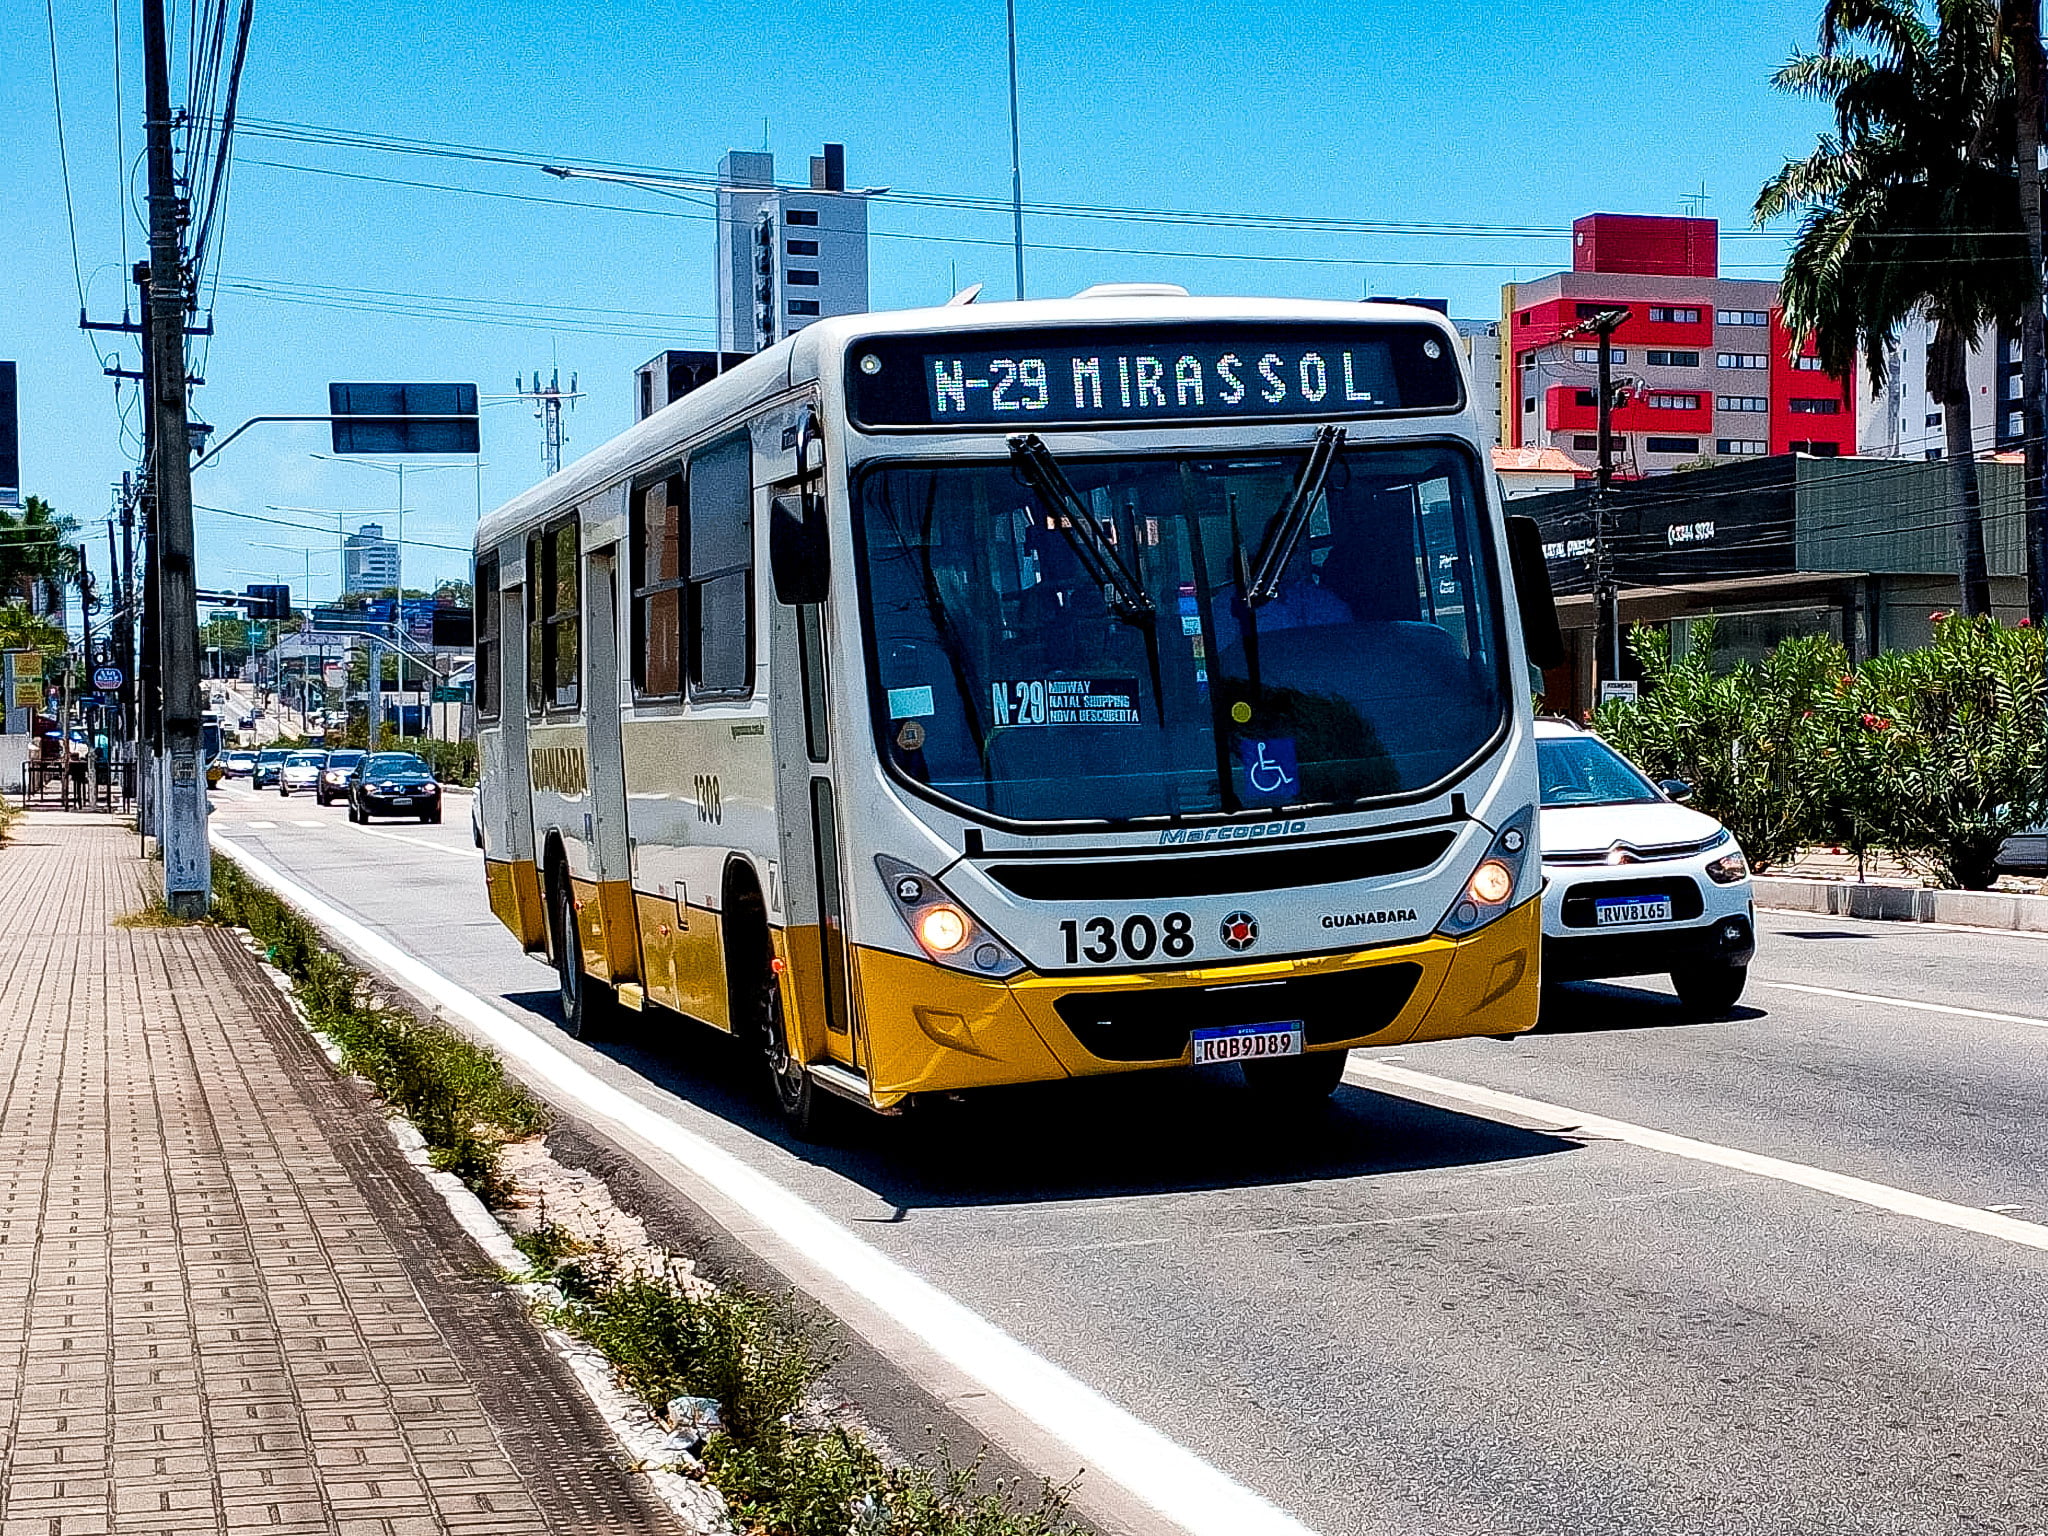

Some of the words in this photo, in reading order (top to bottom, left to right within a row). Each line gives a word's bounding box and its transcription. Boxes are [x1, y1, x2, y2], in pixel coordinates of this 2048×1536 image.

[935, 358, 1049, 412] N-29
[1072, 352, 1371, 409] MIRASSOL
[1048, 681, 1091, 694] MIDWAY
[992, 681, 1045, 724] N-29
[1049, 695, 1081, 708] NATAL
[1083, 695, 1130, 708] SHOPPING
[1050, 709, 1077, 723] NOVA
[532, 747, 588, 794] GUANABARA
[694, 774, 722, 826] 1308
[1159, 820, 1307, 845] Marcopolo
[1321, 908, 1418, 929] GUANABARA
[1603, 903, 1665, 923] RVV8165
[1059, 910, 1195, 965] 1308
[1203, 1033, 1292, 1061] RQB9D89
